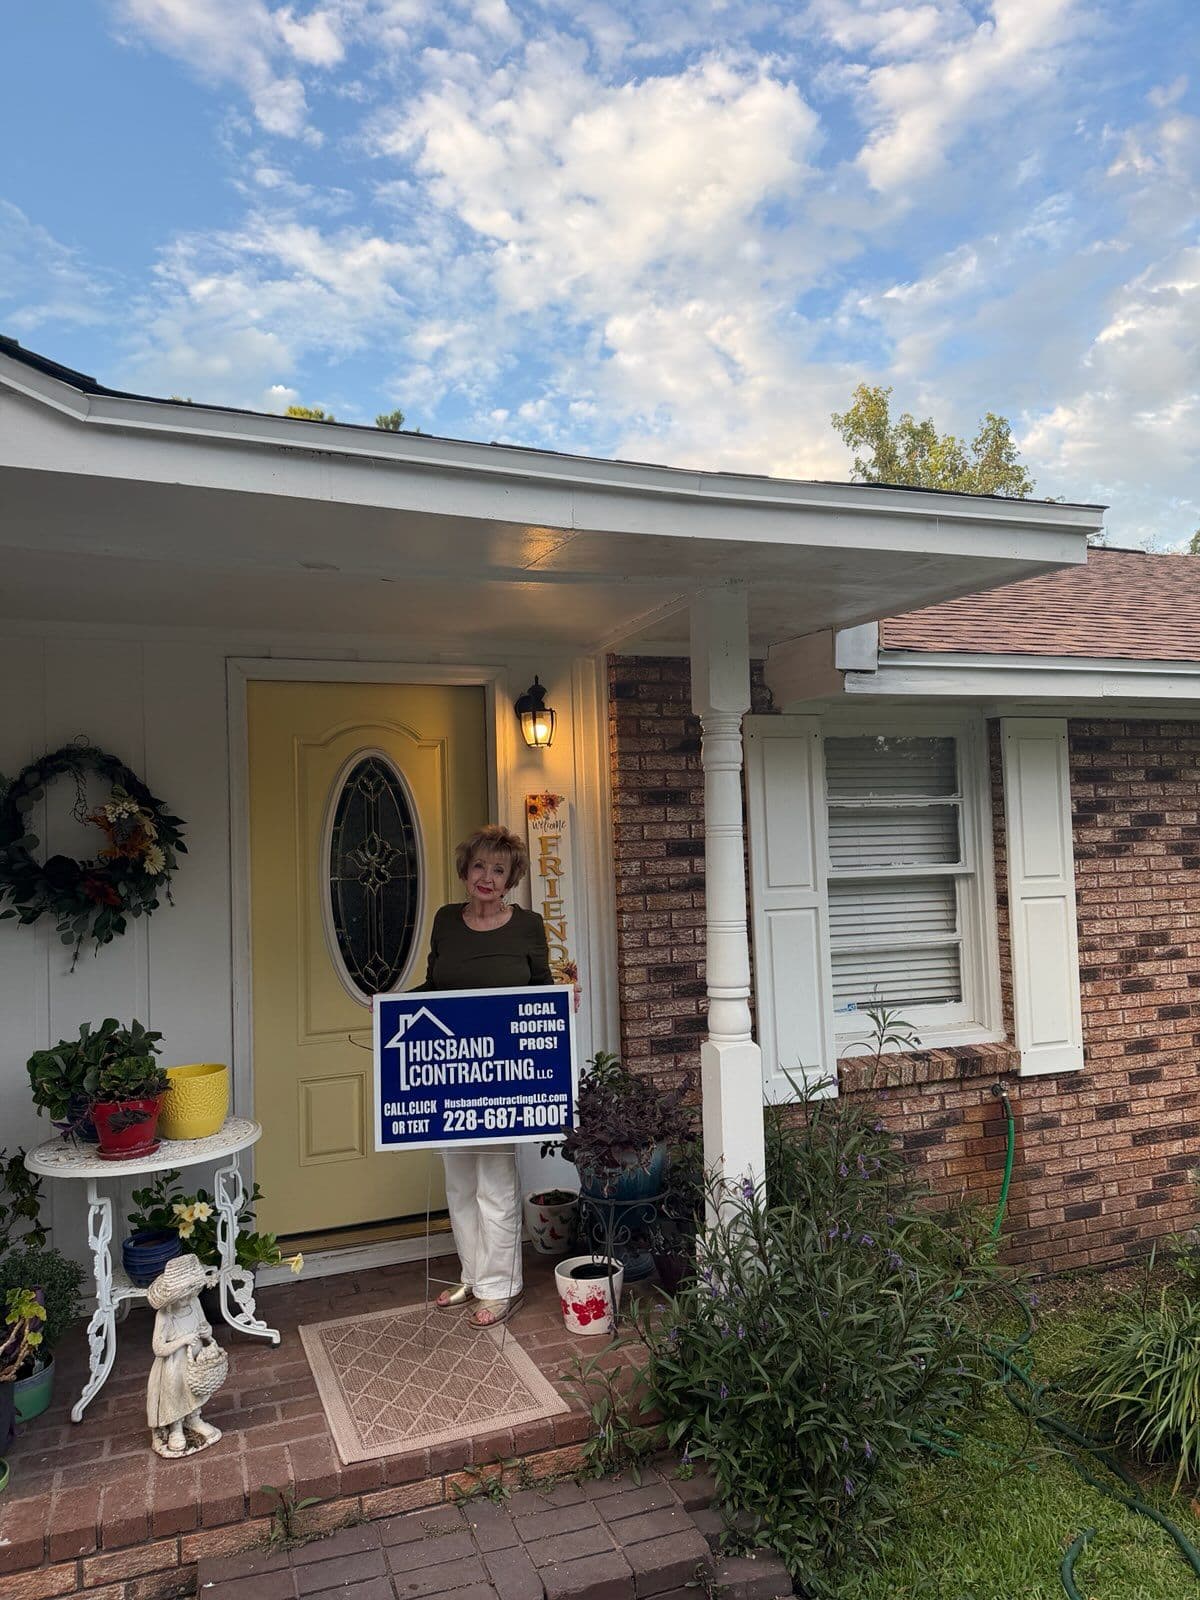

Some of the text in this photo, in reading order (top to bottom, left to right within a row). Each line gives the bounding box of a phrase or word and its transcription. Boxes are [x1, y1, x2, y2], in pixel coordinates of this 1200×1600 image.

[518, 1003, 556, 1016] LOCAL
[511, 1019, 565, 1034] ROOFING
[409, 1037, 495, 1062] HUSBAND
[519, 1037, 558, 1050] PROS!
[409, 1059, 554, 1087] CONTRACTING LLC
[444, 1094, 568, 1108] HusbandContractingLLC.com
[443, 1105, 568, 1132] 228-687-ROOF
[392, 1119, 430, 1134] OR TEXT
